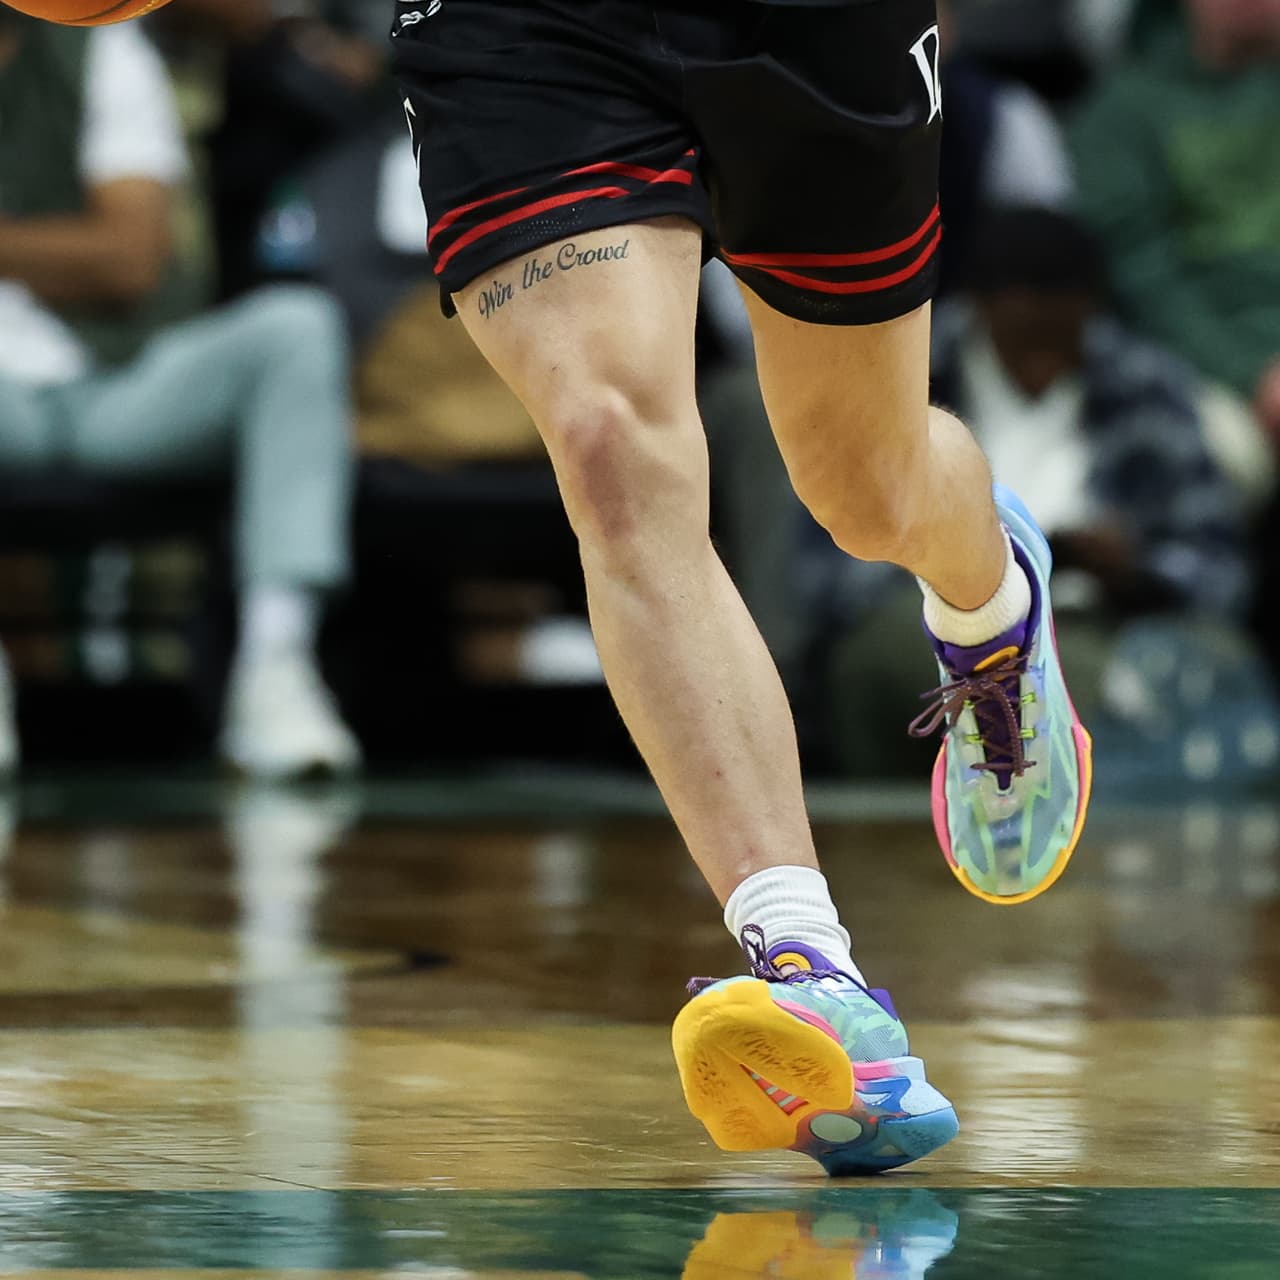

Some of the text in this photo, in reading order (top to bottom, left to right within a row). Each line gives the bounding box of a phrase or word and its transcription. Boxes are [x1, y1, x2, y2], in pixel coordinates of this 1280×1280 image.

[478, 239, 630, 319] Win the Crowd
